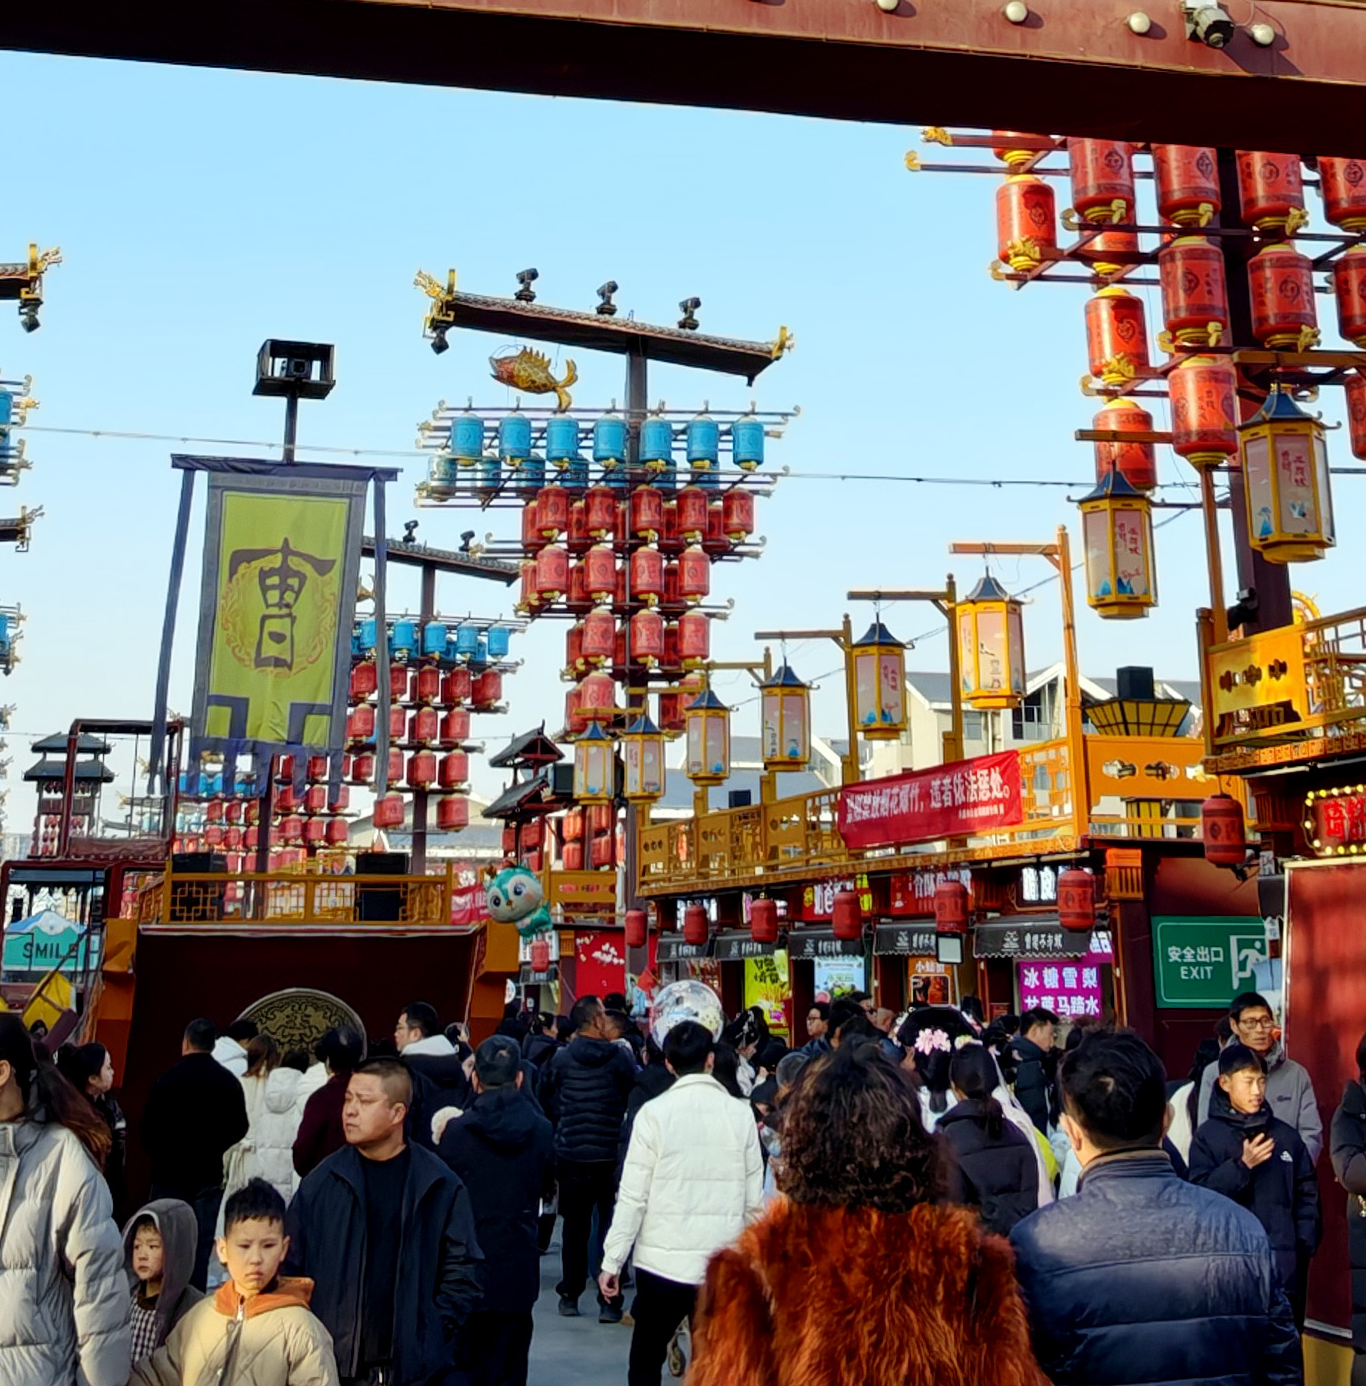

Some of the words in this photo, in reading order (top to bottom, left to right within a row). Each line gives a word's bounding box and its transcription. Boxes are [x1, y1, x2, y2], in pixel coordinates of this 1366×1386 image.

[22, 942, 78, 960] SMILE
[1167, 946, 1224, 963] 安全出口
[1023, 966, 1098, 989] 冰糖雪梨
[1180, 966, 1213, 980] EXIT
